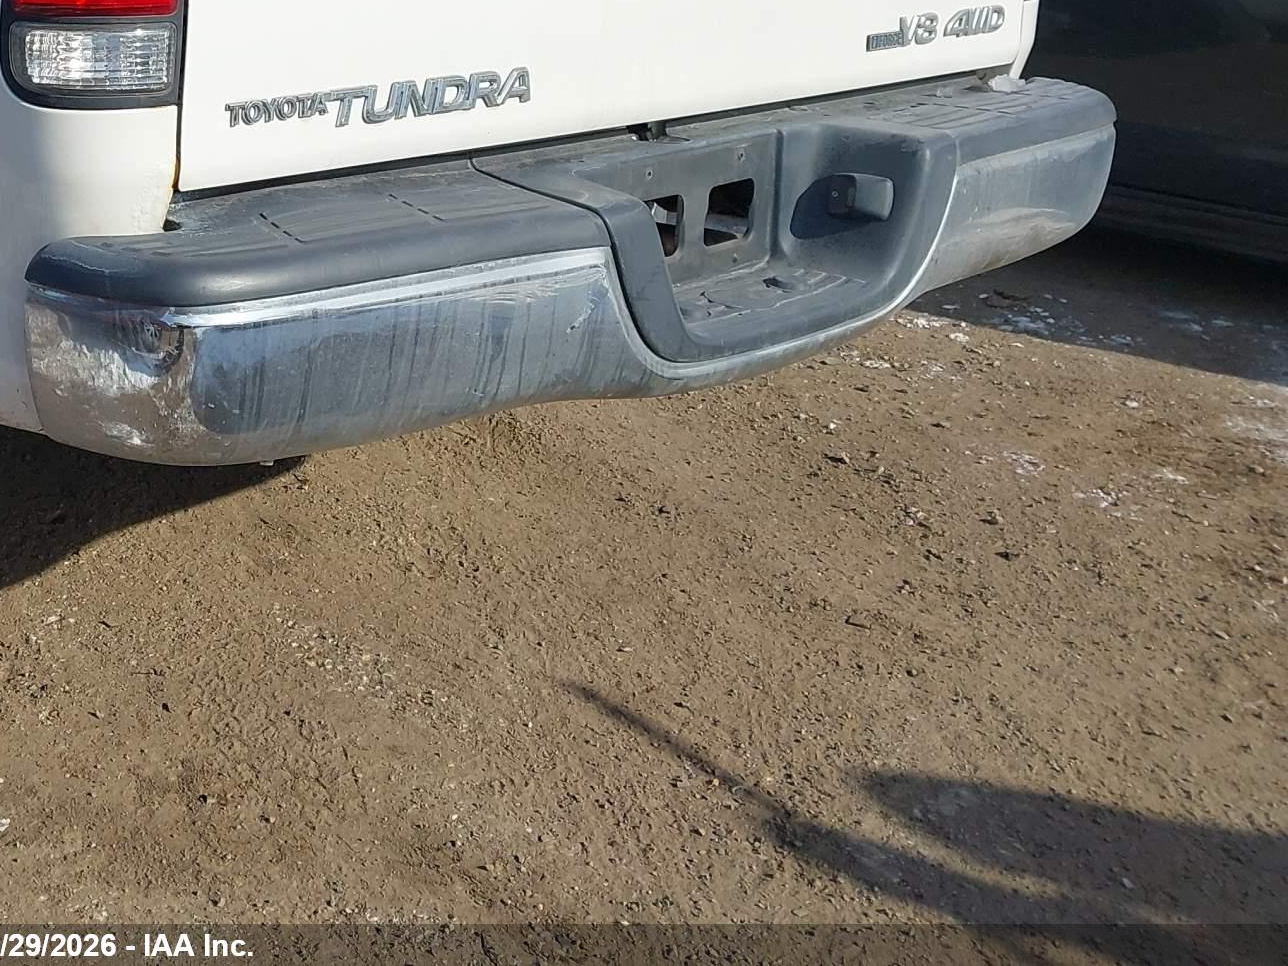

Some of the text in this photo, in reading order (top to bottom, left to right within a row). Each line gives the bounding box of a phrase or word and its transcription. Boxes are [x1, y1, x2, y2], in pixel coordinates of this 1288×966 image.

[899, 11, 939, 47] V8
[943, 4, 1006, 38] 4WD
[224, 66, 532, 128] TOYOTA TUNDRA
